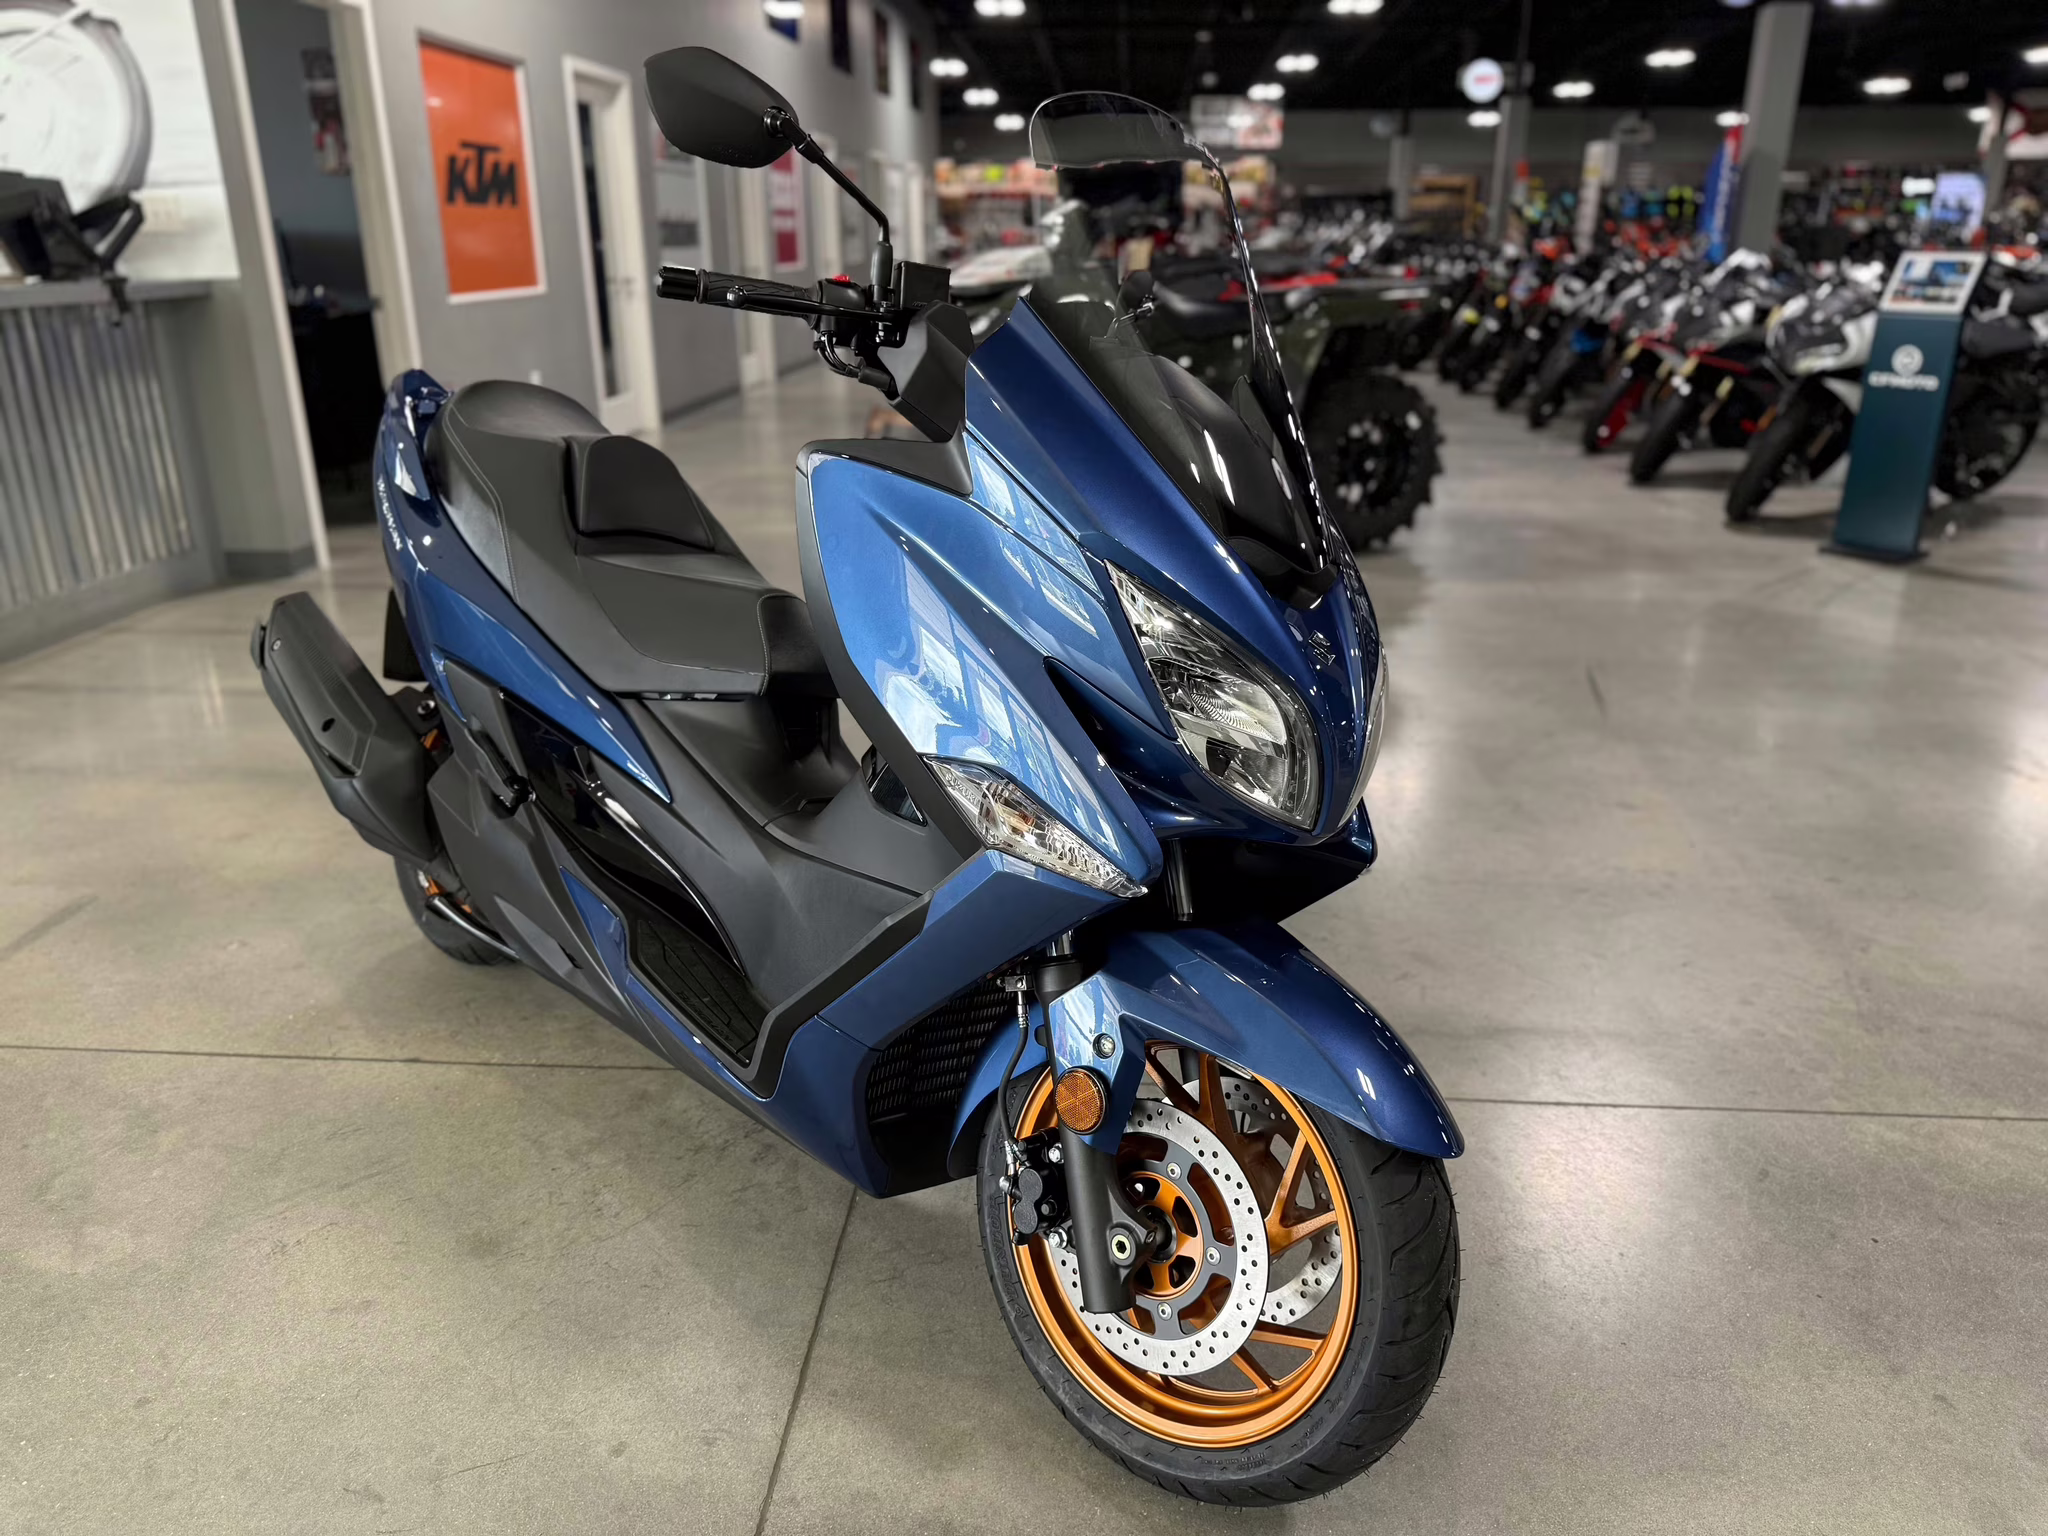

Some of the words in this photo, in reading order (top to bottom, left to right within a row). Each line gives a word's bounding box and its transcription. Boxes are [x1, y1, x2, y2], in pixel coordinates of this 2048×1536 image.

[447, 141, 517, 206] KTM
[945, 772, 979, 806] SUZUKI
[989, 1194, 1018, 1300] DUNLOP
